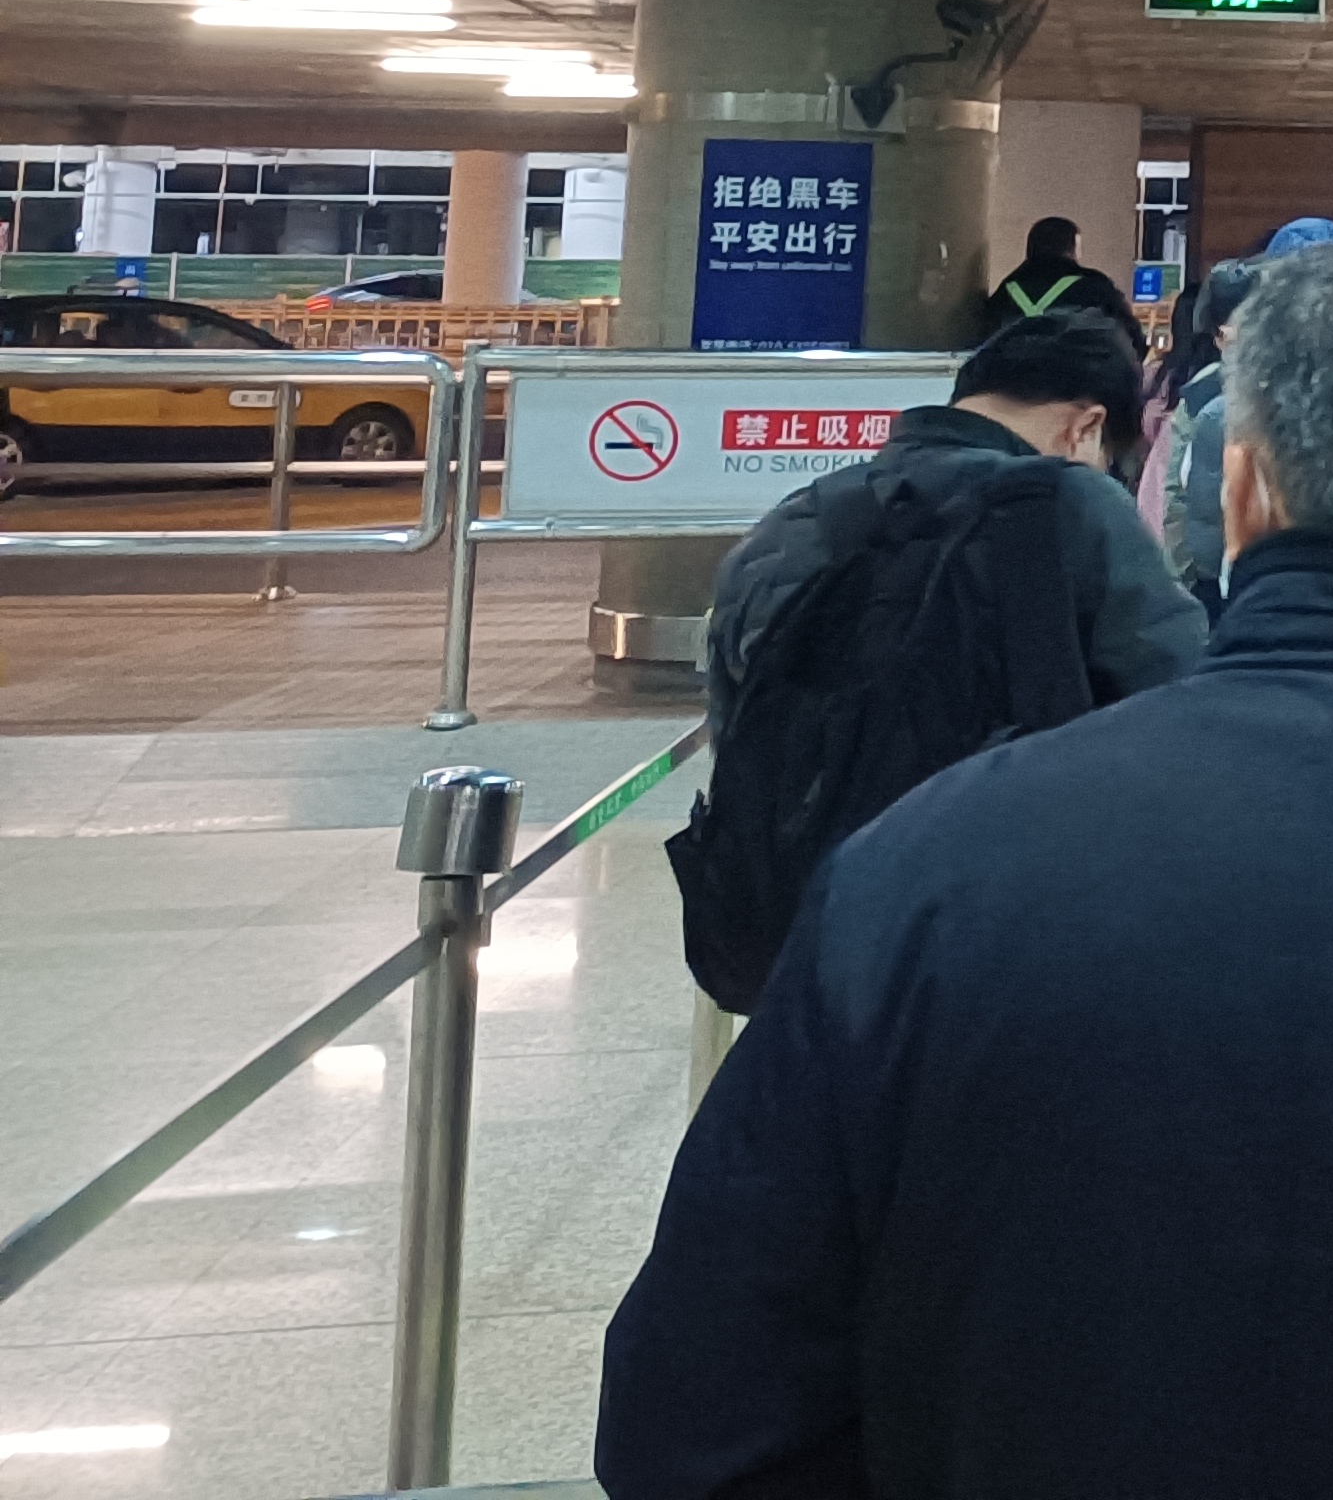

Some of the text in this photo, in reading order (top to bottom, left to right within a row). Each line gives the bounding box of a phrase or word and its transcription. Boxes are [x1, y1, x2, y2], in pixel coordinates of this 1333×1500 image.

[713, 175, 860, 210] 拒绝黑车
[709, 220, 858, 255] 平安出行
[736, 414, 891, 447] 禁止吸烟
[724, 454, 866, 473] NO SMOKI
